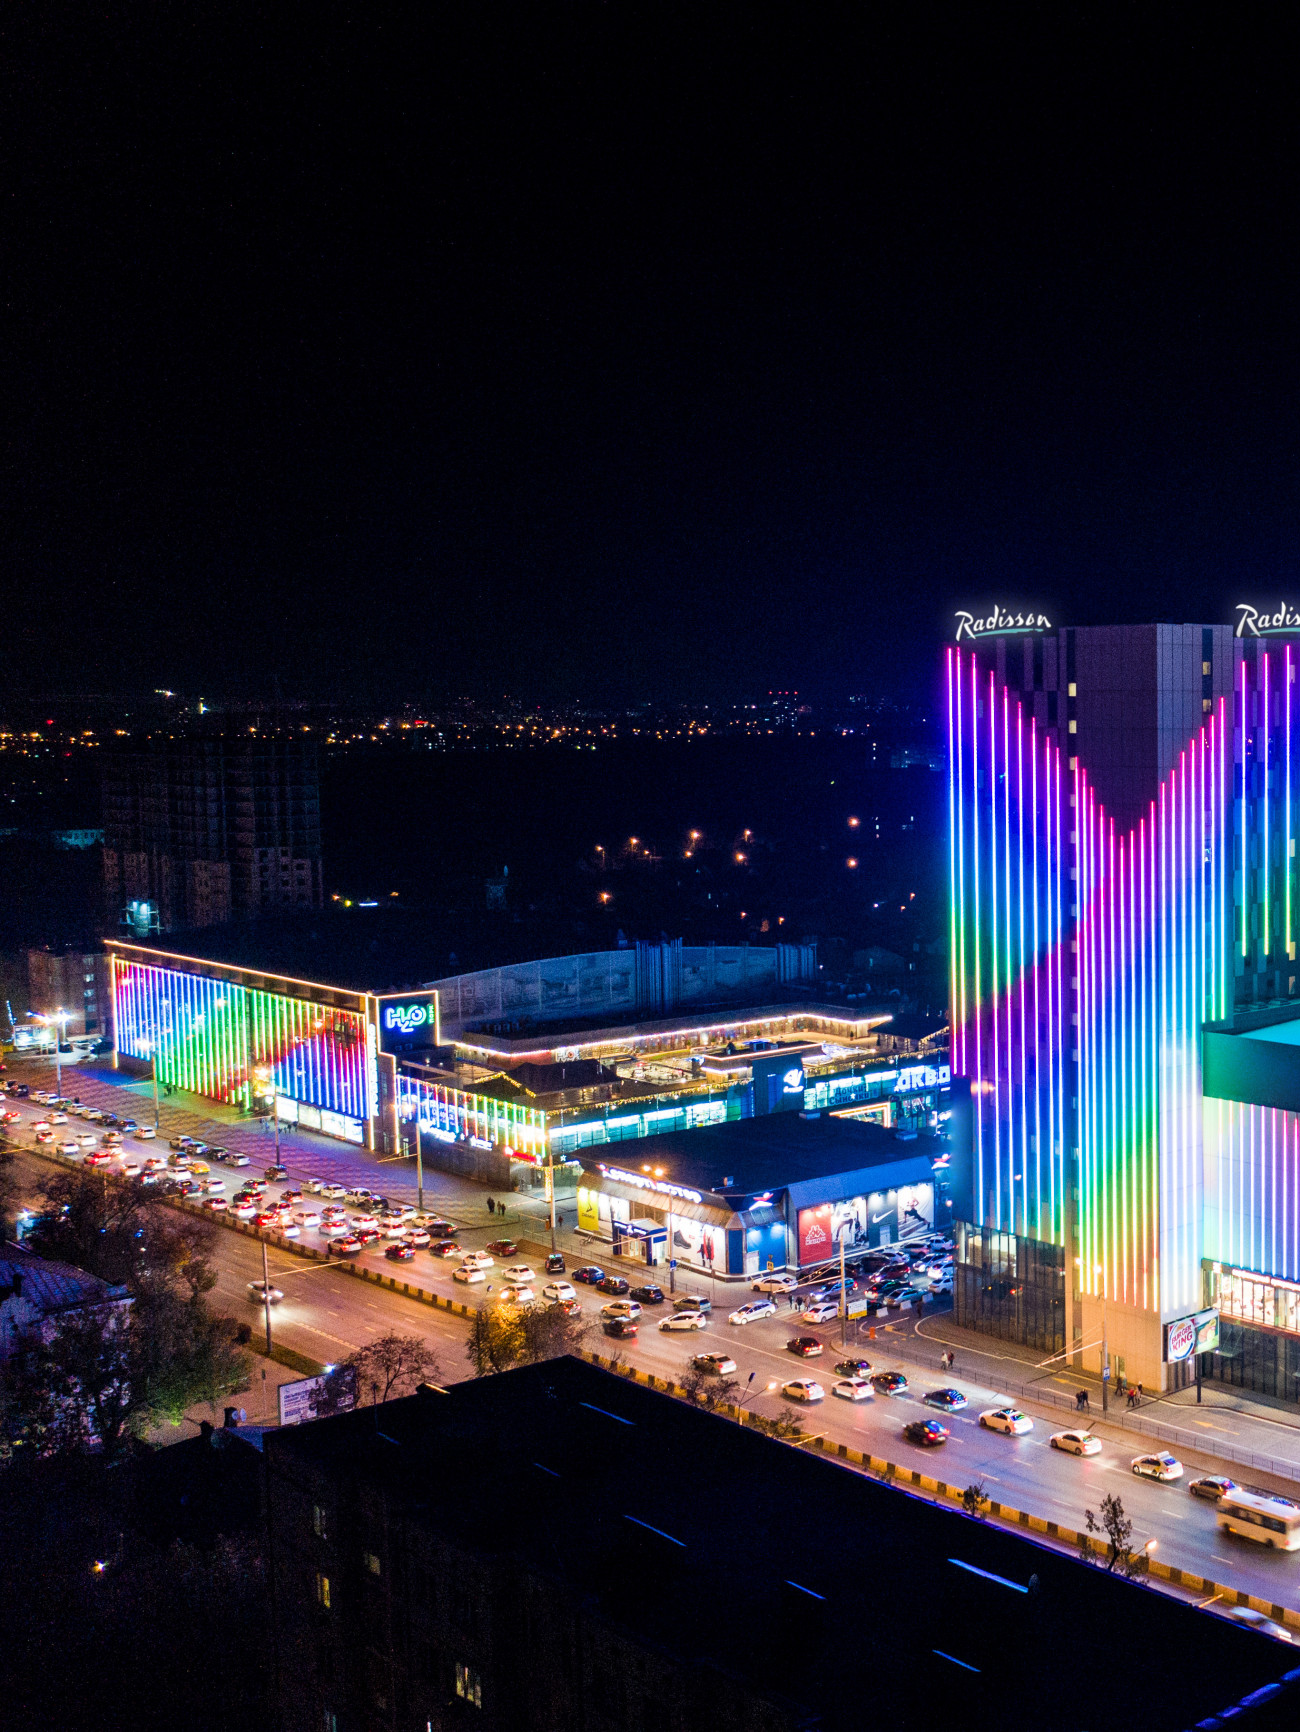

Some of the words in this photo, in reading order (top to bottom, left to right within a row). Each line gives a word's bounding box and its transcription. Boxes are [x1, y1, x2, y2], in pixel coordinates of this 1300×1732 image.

[954, 605, 1052, 642] Radisson
[1172, 1325, 1191, 1345] BURGER
[1173, 1331, 1193, 1350] KING
